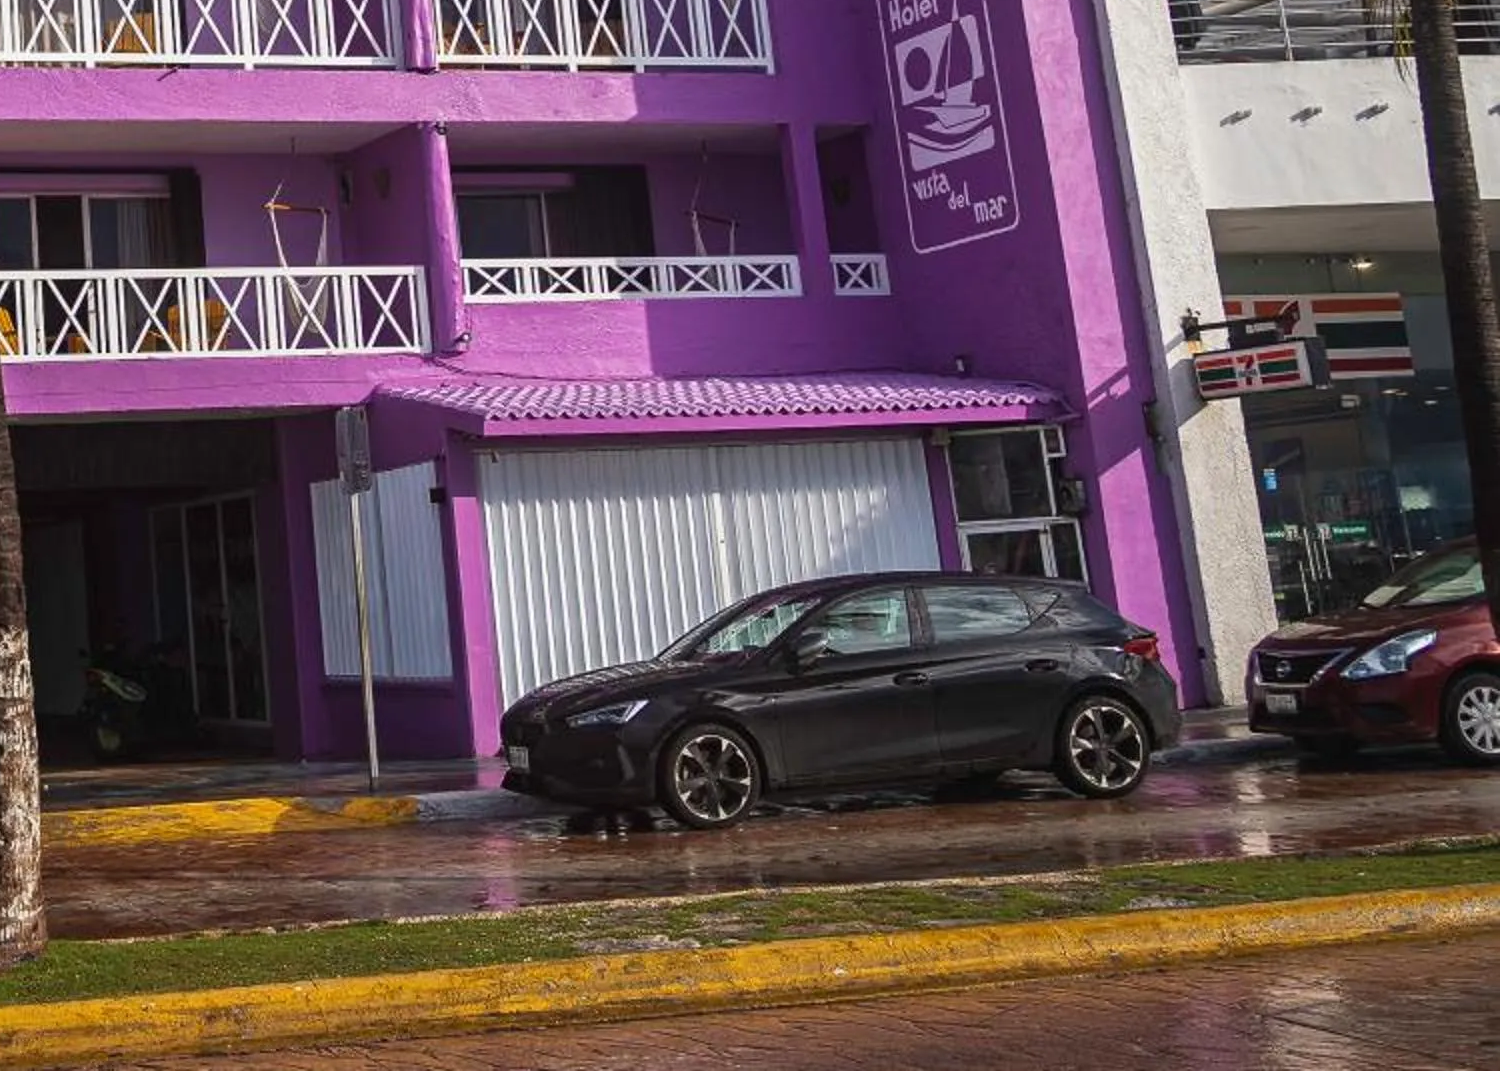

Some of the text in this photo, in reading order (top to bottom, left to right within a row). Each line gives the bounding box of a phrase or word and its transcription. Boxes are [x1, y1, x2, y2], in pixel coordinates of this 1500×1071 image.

[913, 170, 1007, 223] vista del mar
